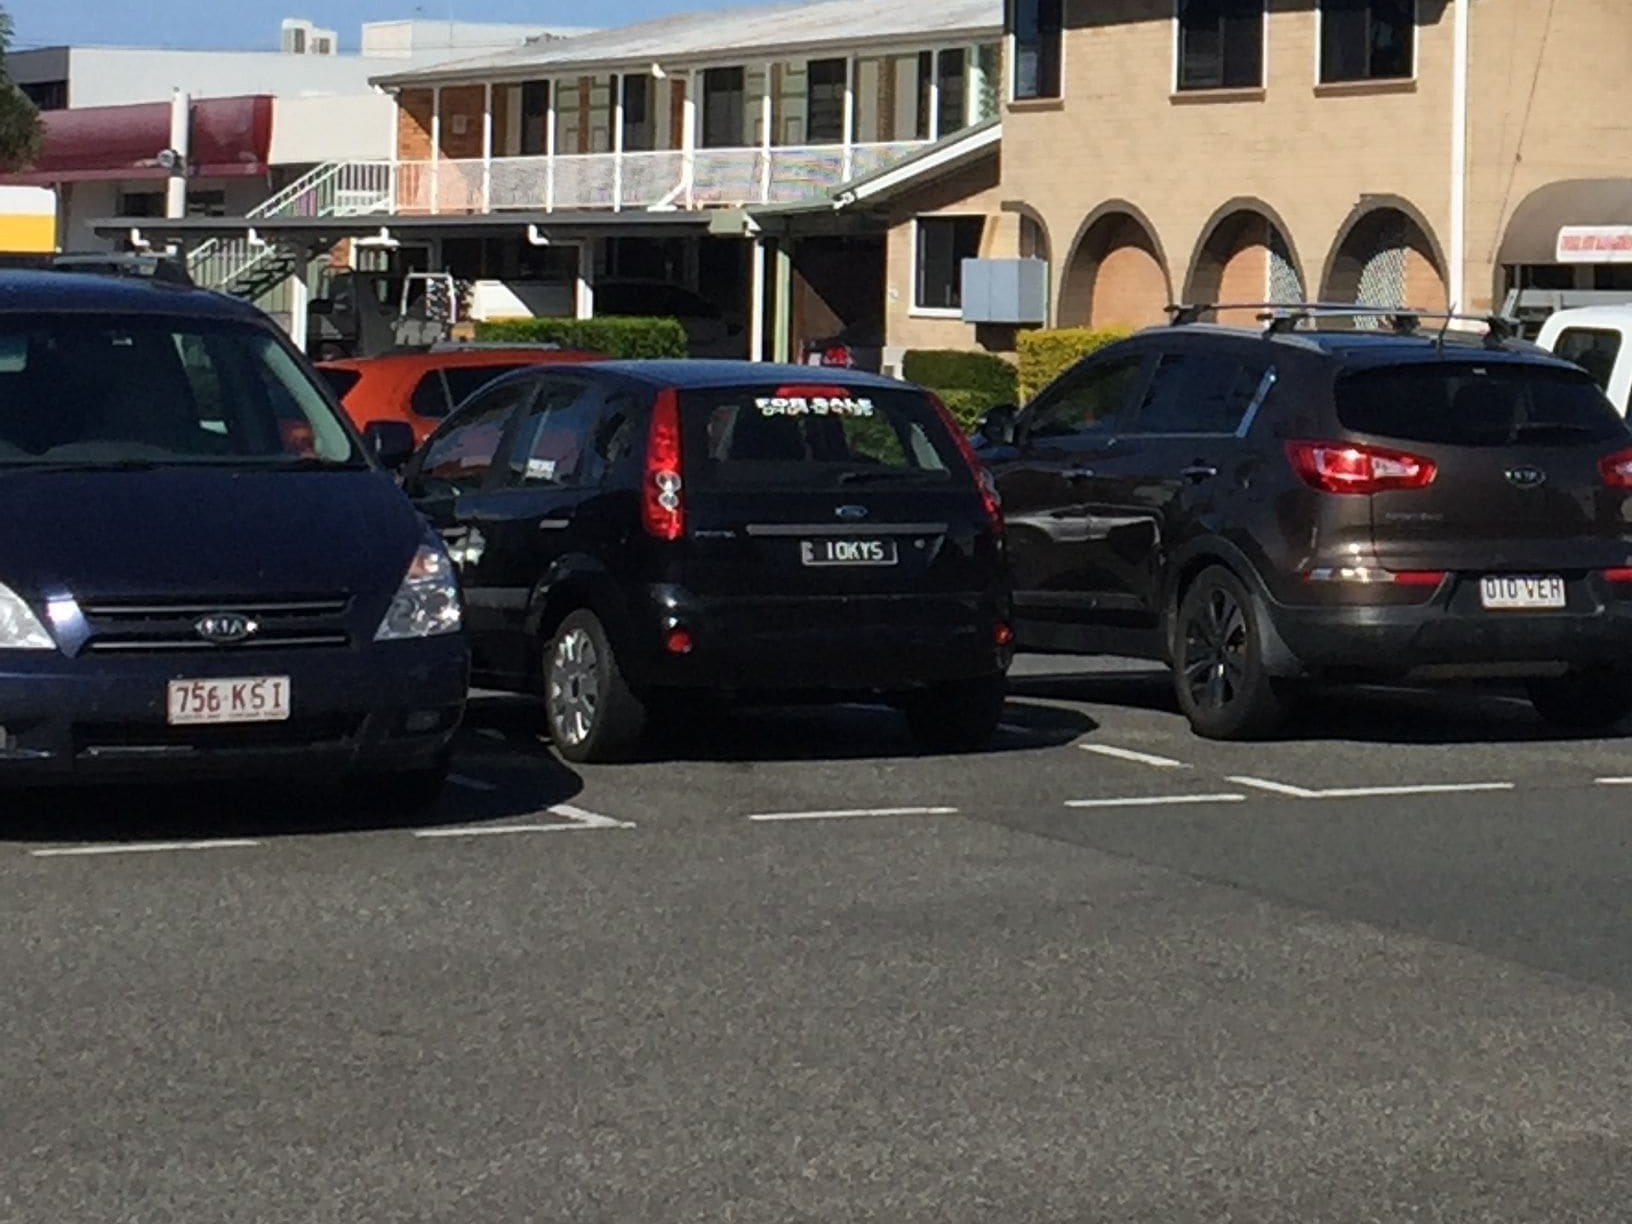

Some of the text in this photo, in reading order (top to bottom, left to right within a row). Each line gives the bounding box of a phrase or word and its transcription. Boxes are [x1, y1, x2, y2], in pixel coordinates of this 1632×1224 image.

[205, 618, 243, 634] KIA
[177, 681, 282, 713] 756 KSI
